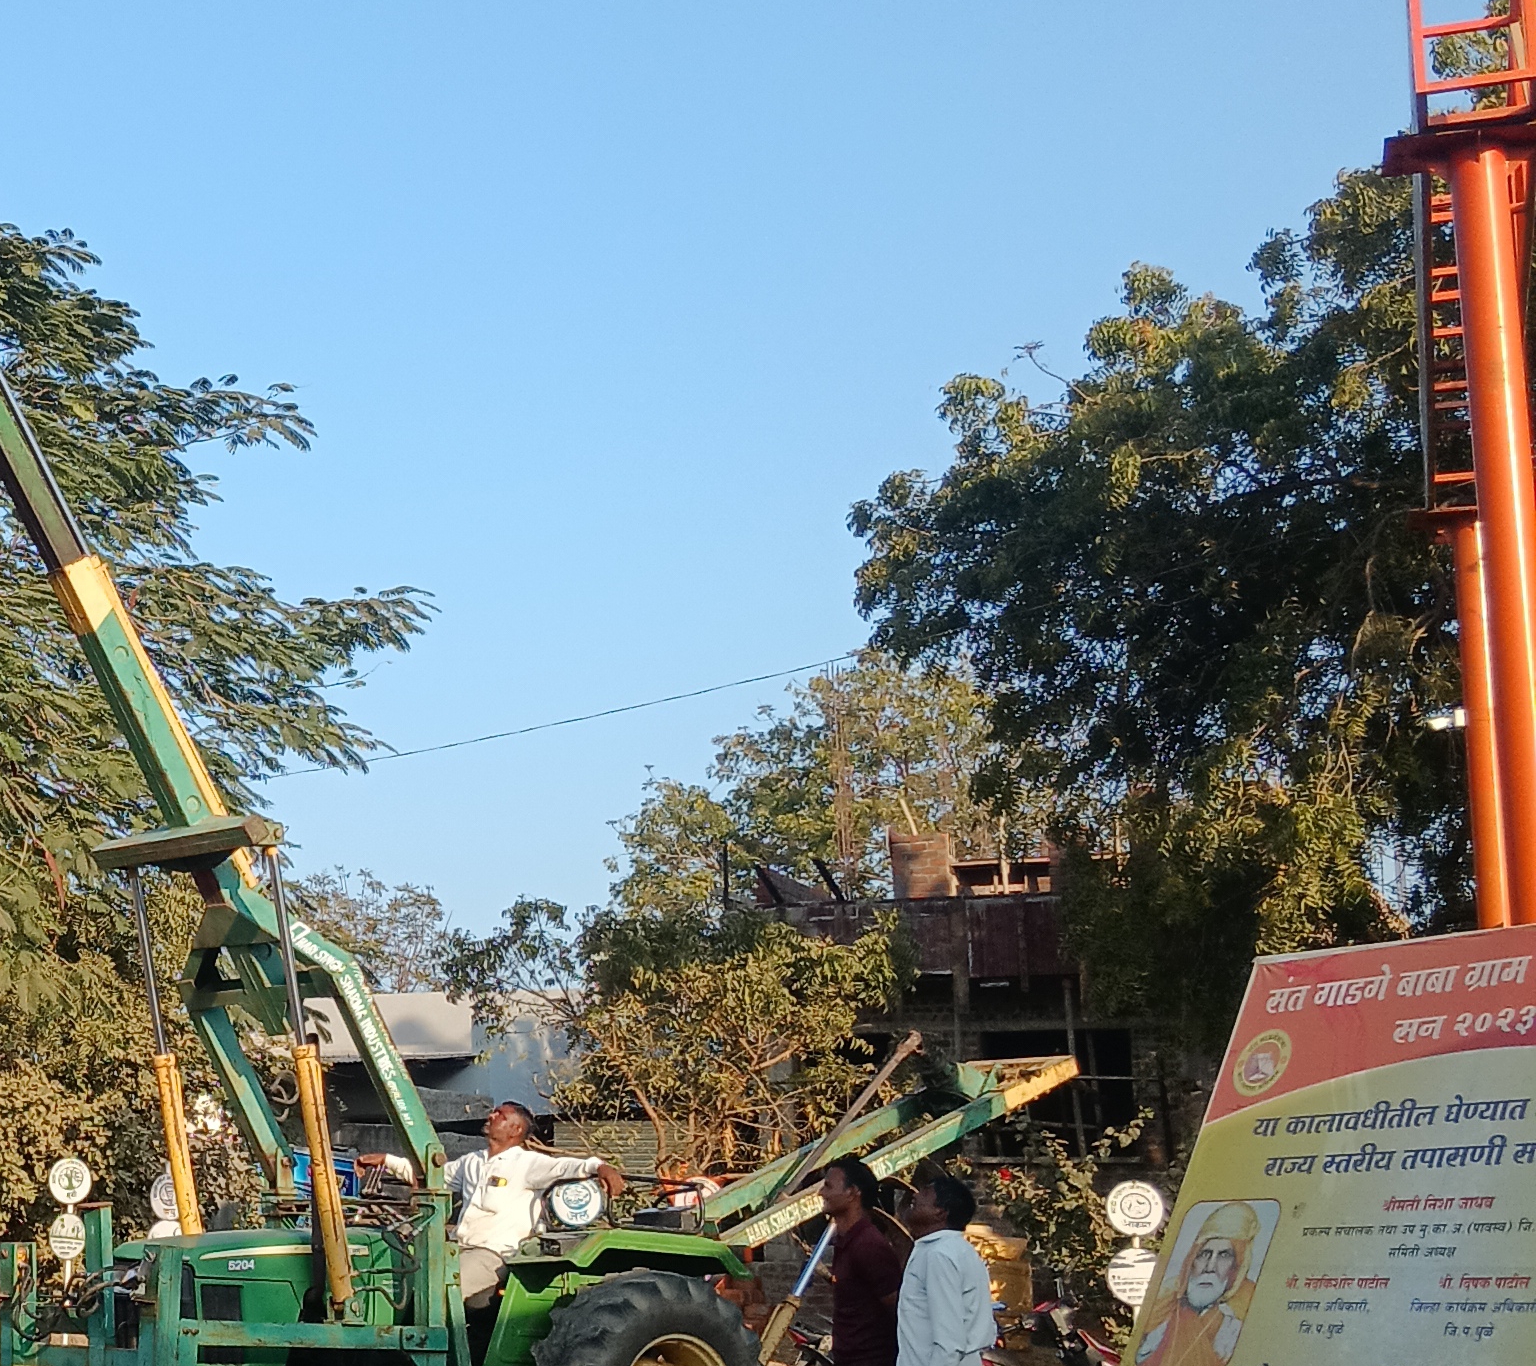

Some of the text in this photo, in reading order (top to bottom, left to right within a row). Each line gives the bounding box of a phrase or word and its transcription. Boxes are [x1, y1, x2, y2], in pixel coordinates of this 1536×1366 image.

[1265, 955, 1533, 1014] संत गाडगे बाबा ग्राम
[339, 974, 367, 1020] SHARMA
[362, 1016, 396, 1081] INDUSTRIES
[1392, 1014, 1448, 1044] सन
[1252, 1094, 1531, 1137] या कालावधीतील घेण्यात
[1264, 1154, 1319, 1177] राज्य
[1322, 1142, 1397, 1175] स्तरीय
[1400, 1134, 1508, 1172] तपासणी
[1382, 1194, 1421, 1212] श्रीमती
[1422, 1193, 1455, 1211] निशा
[566, 1209, 591, 1222] जल
[1388, 1243, 1421, 1259] समिती
[227, 1258, 255, 1271] 5204
[1357, 1274, 1391, 1290] पाटील
[1495, 1273, 1532, 1290] पाटील
